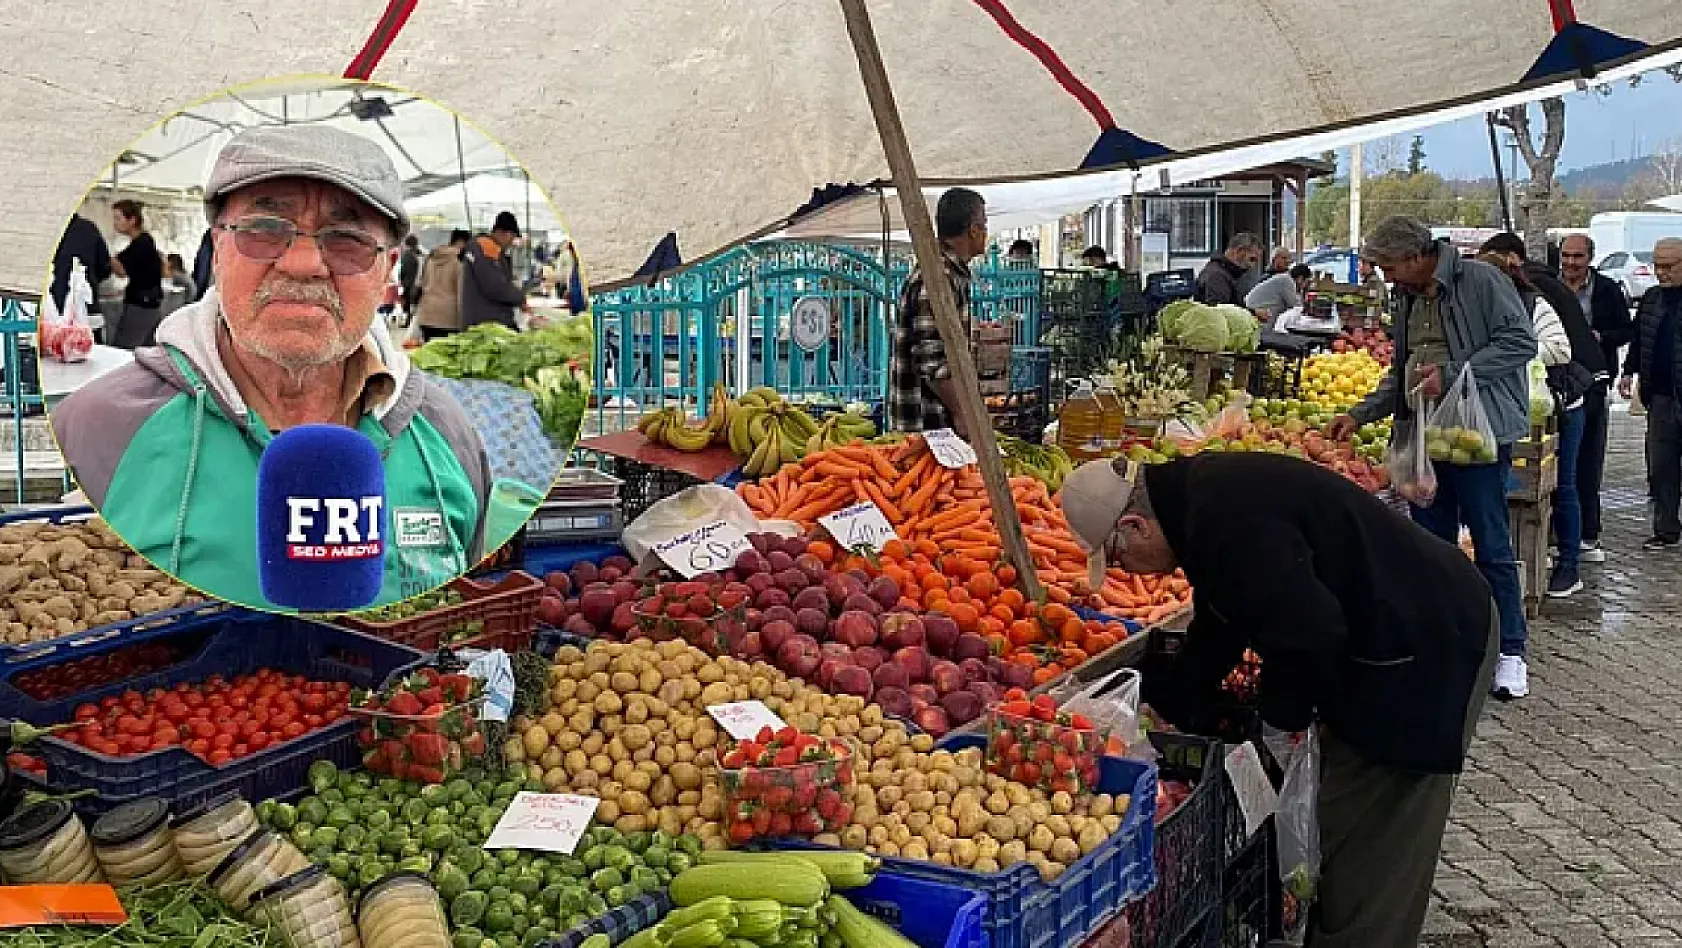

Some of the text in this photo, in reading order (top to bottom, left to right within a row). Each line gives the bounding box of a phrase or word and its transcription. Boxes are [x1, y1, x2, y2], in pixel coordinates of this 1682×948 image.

[286, 496, 382, 543] FRT
[847, 518, 874, 545] 40
[293, 543, 380, 557] SED MEDYA
[689, 542, 731, 570] 60
